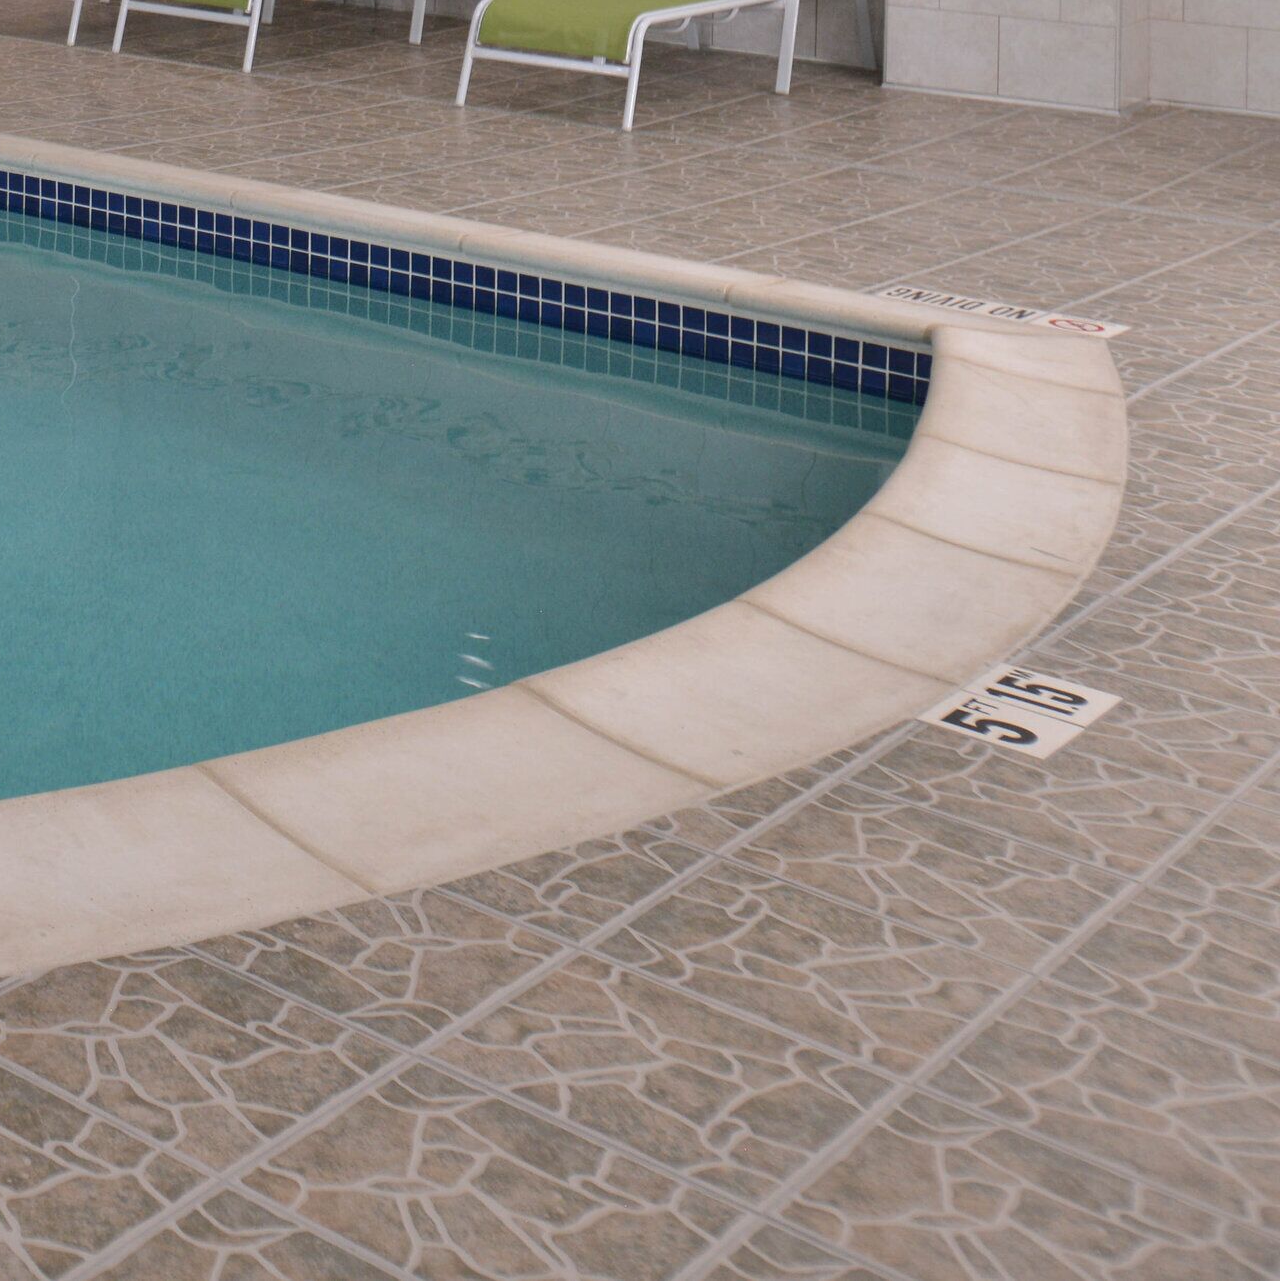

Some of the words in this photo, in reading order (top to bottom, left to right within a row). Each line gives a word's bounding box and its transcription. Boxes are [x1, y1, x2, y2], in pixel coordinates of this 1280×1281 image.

[886, 287, 986, 311] DIVING
[988, 305, 1037, 321] NO
[941, 708, 1039, 746] 5
